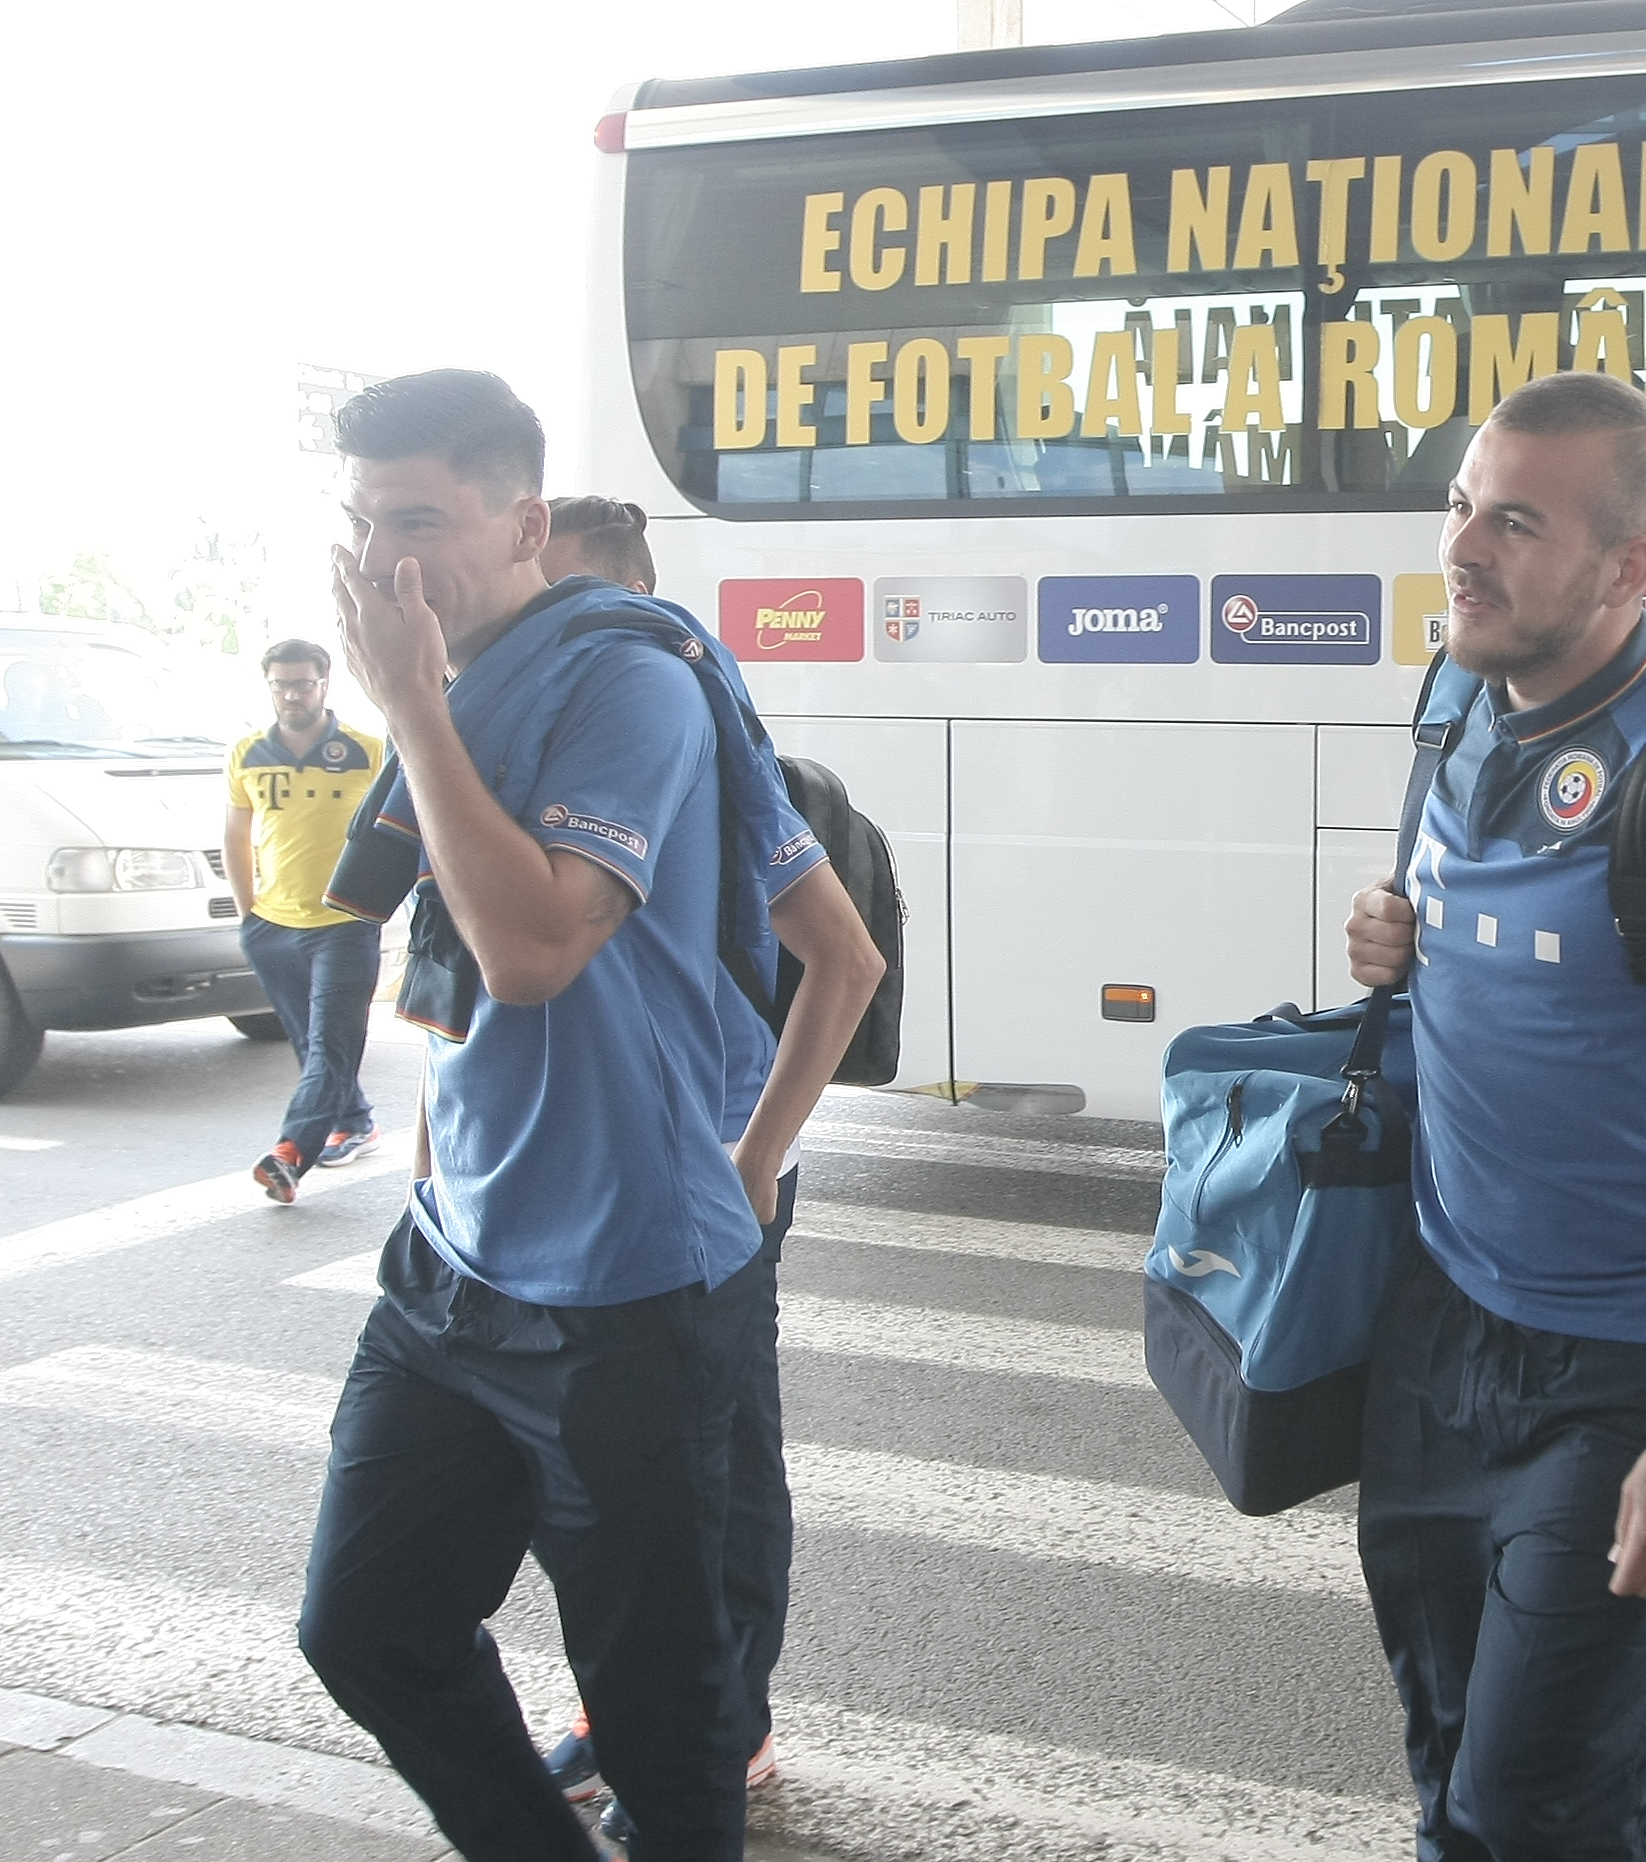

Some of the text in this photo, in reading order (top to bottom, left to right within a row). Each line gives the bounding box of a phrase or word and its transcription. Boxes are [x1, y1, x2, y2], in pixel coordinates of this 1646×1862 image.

[799, 172, 1138, 293] ECHIPA
[713, 344, 817, 450] DE
[845, 328, 1193, 445] FOTBAL
[1221, 323, 1286, 433] A
[755, 608, 827, 629] PENNY
[978, 611, 1017, 621] AUTO
[1260, 617, 1358, 640] Bancpost
[567, 816, 639, 849] Bancpost
